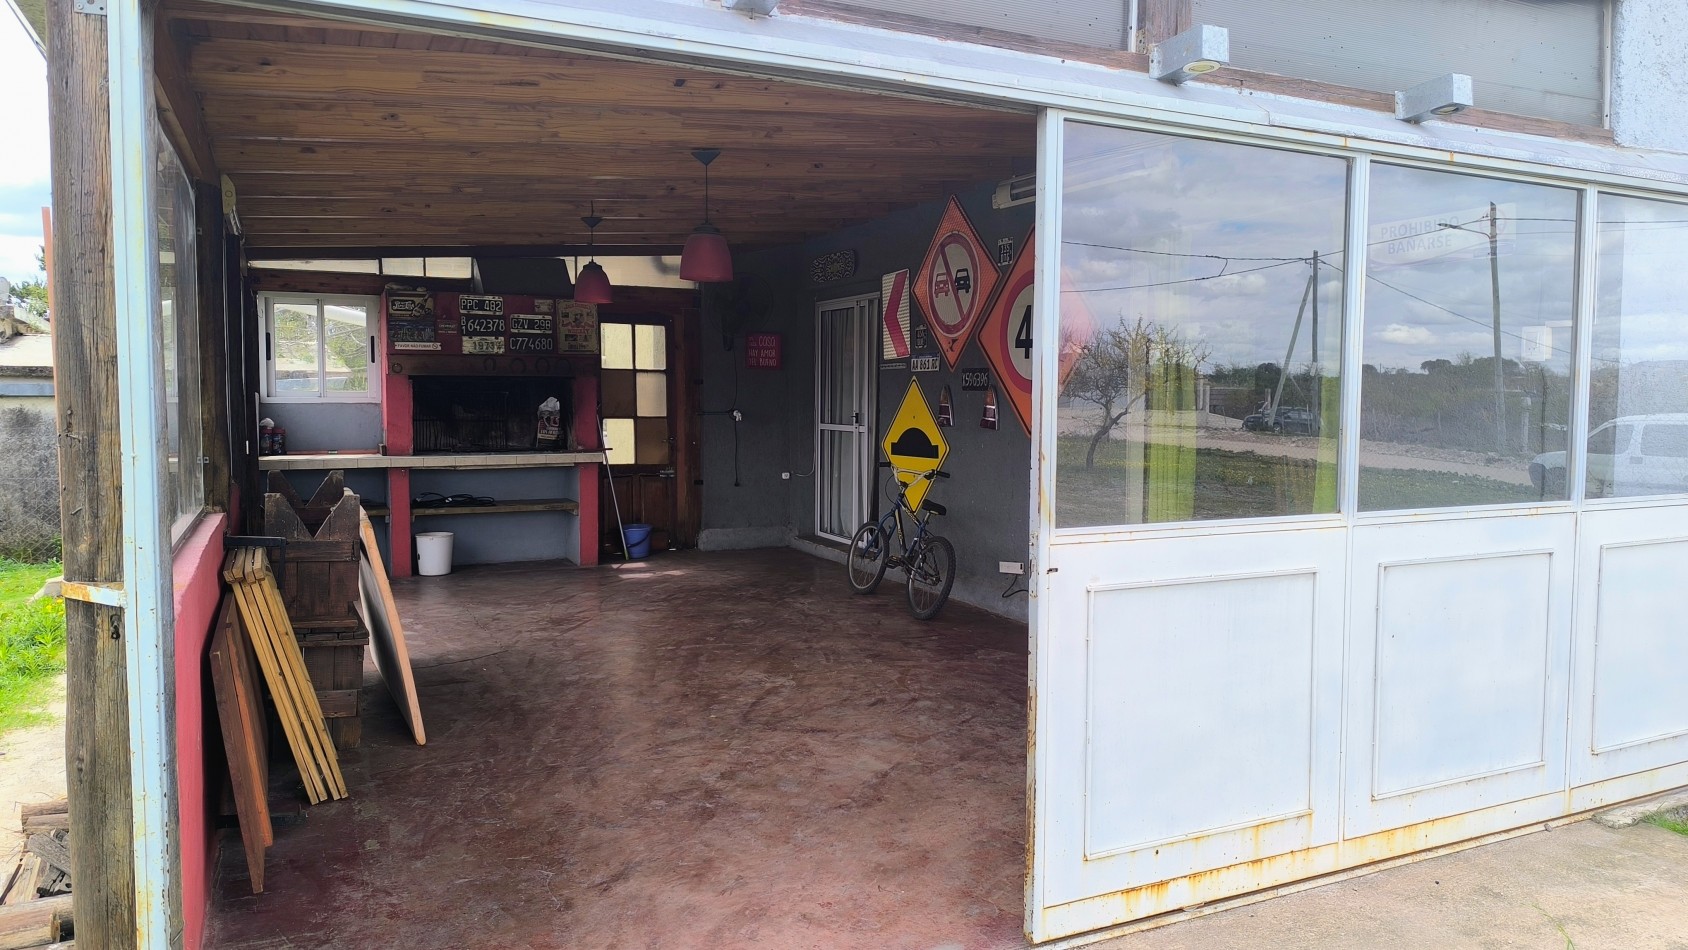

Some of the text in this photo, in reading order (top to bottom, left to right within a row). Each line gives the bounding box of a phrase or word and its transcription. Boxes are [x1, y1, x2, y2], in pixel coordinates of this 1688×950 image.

[461, 299, 502, 311] PPC 482
[467, 319, 505, 332] 642378
[1015, 305, 1033, 359] 4
[509, 337, 553, 350] C774680
